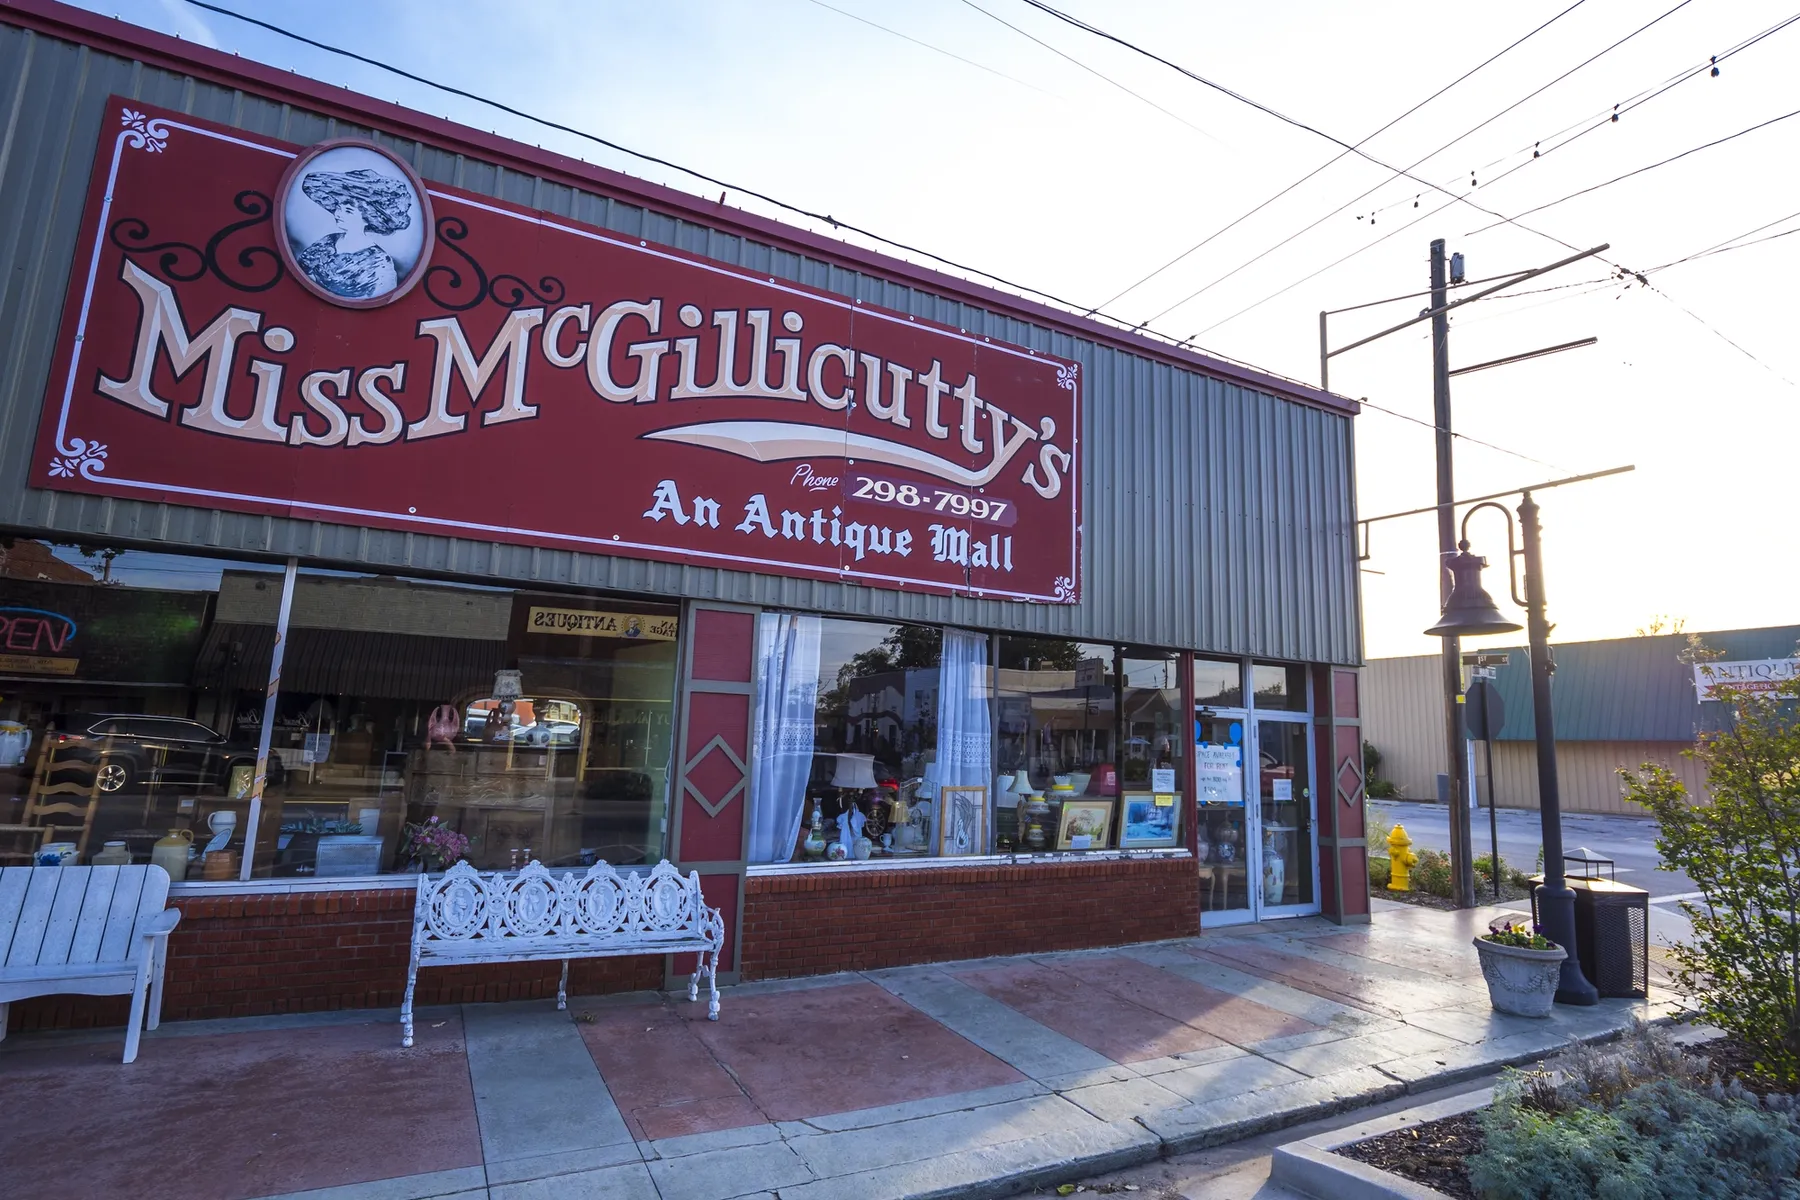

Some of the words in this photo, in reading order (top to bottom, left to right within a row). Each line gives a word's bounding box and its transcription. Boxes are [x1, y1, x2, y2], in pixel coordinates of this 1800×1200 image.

[97, 257, 405, 447] Miss
[643, 479, 720, 528] An
[735, 493, 913, 562] Antique
[928, 523, 1013, 572] Mall
[790, 464, 839, 487] Phone
[852, 476, 1008, 521] 298-7997
